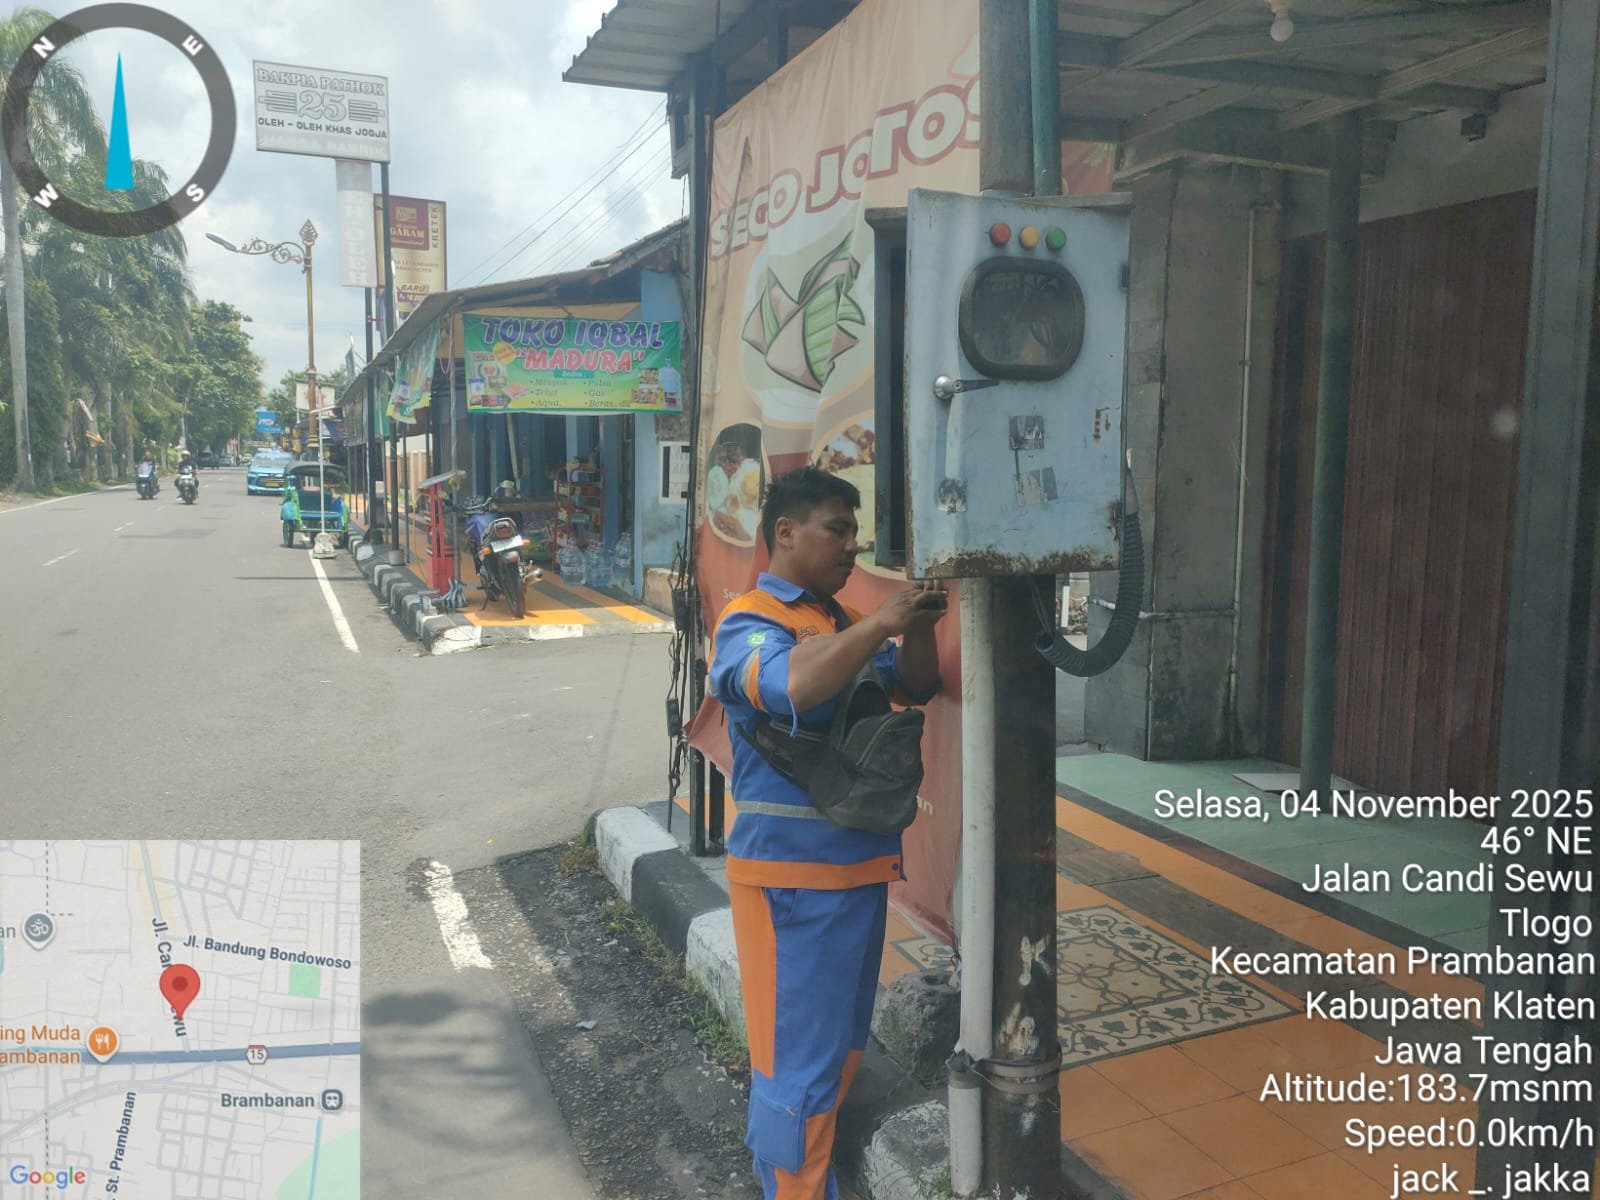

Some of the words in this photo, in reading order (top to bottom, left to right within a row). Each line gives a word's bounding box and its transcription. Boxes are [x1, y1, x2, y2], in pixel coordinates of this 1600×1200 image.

[256, 68, 318, 88] BAKPIA
[319, 76, 385, 96] PATHOK
[298, 89, 347, 122] 25
[257, 117, 285, 128] OLEH
[296, 121, 323, 132] OLEH
[325, 124, 352, 136] KHAS
[431, 206, 440, 249] KRETEK
[481, 317, 565, 347] TOKO
[574, 320, 665, 350] IQBAL
